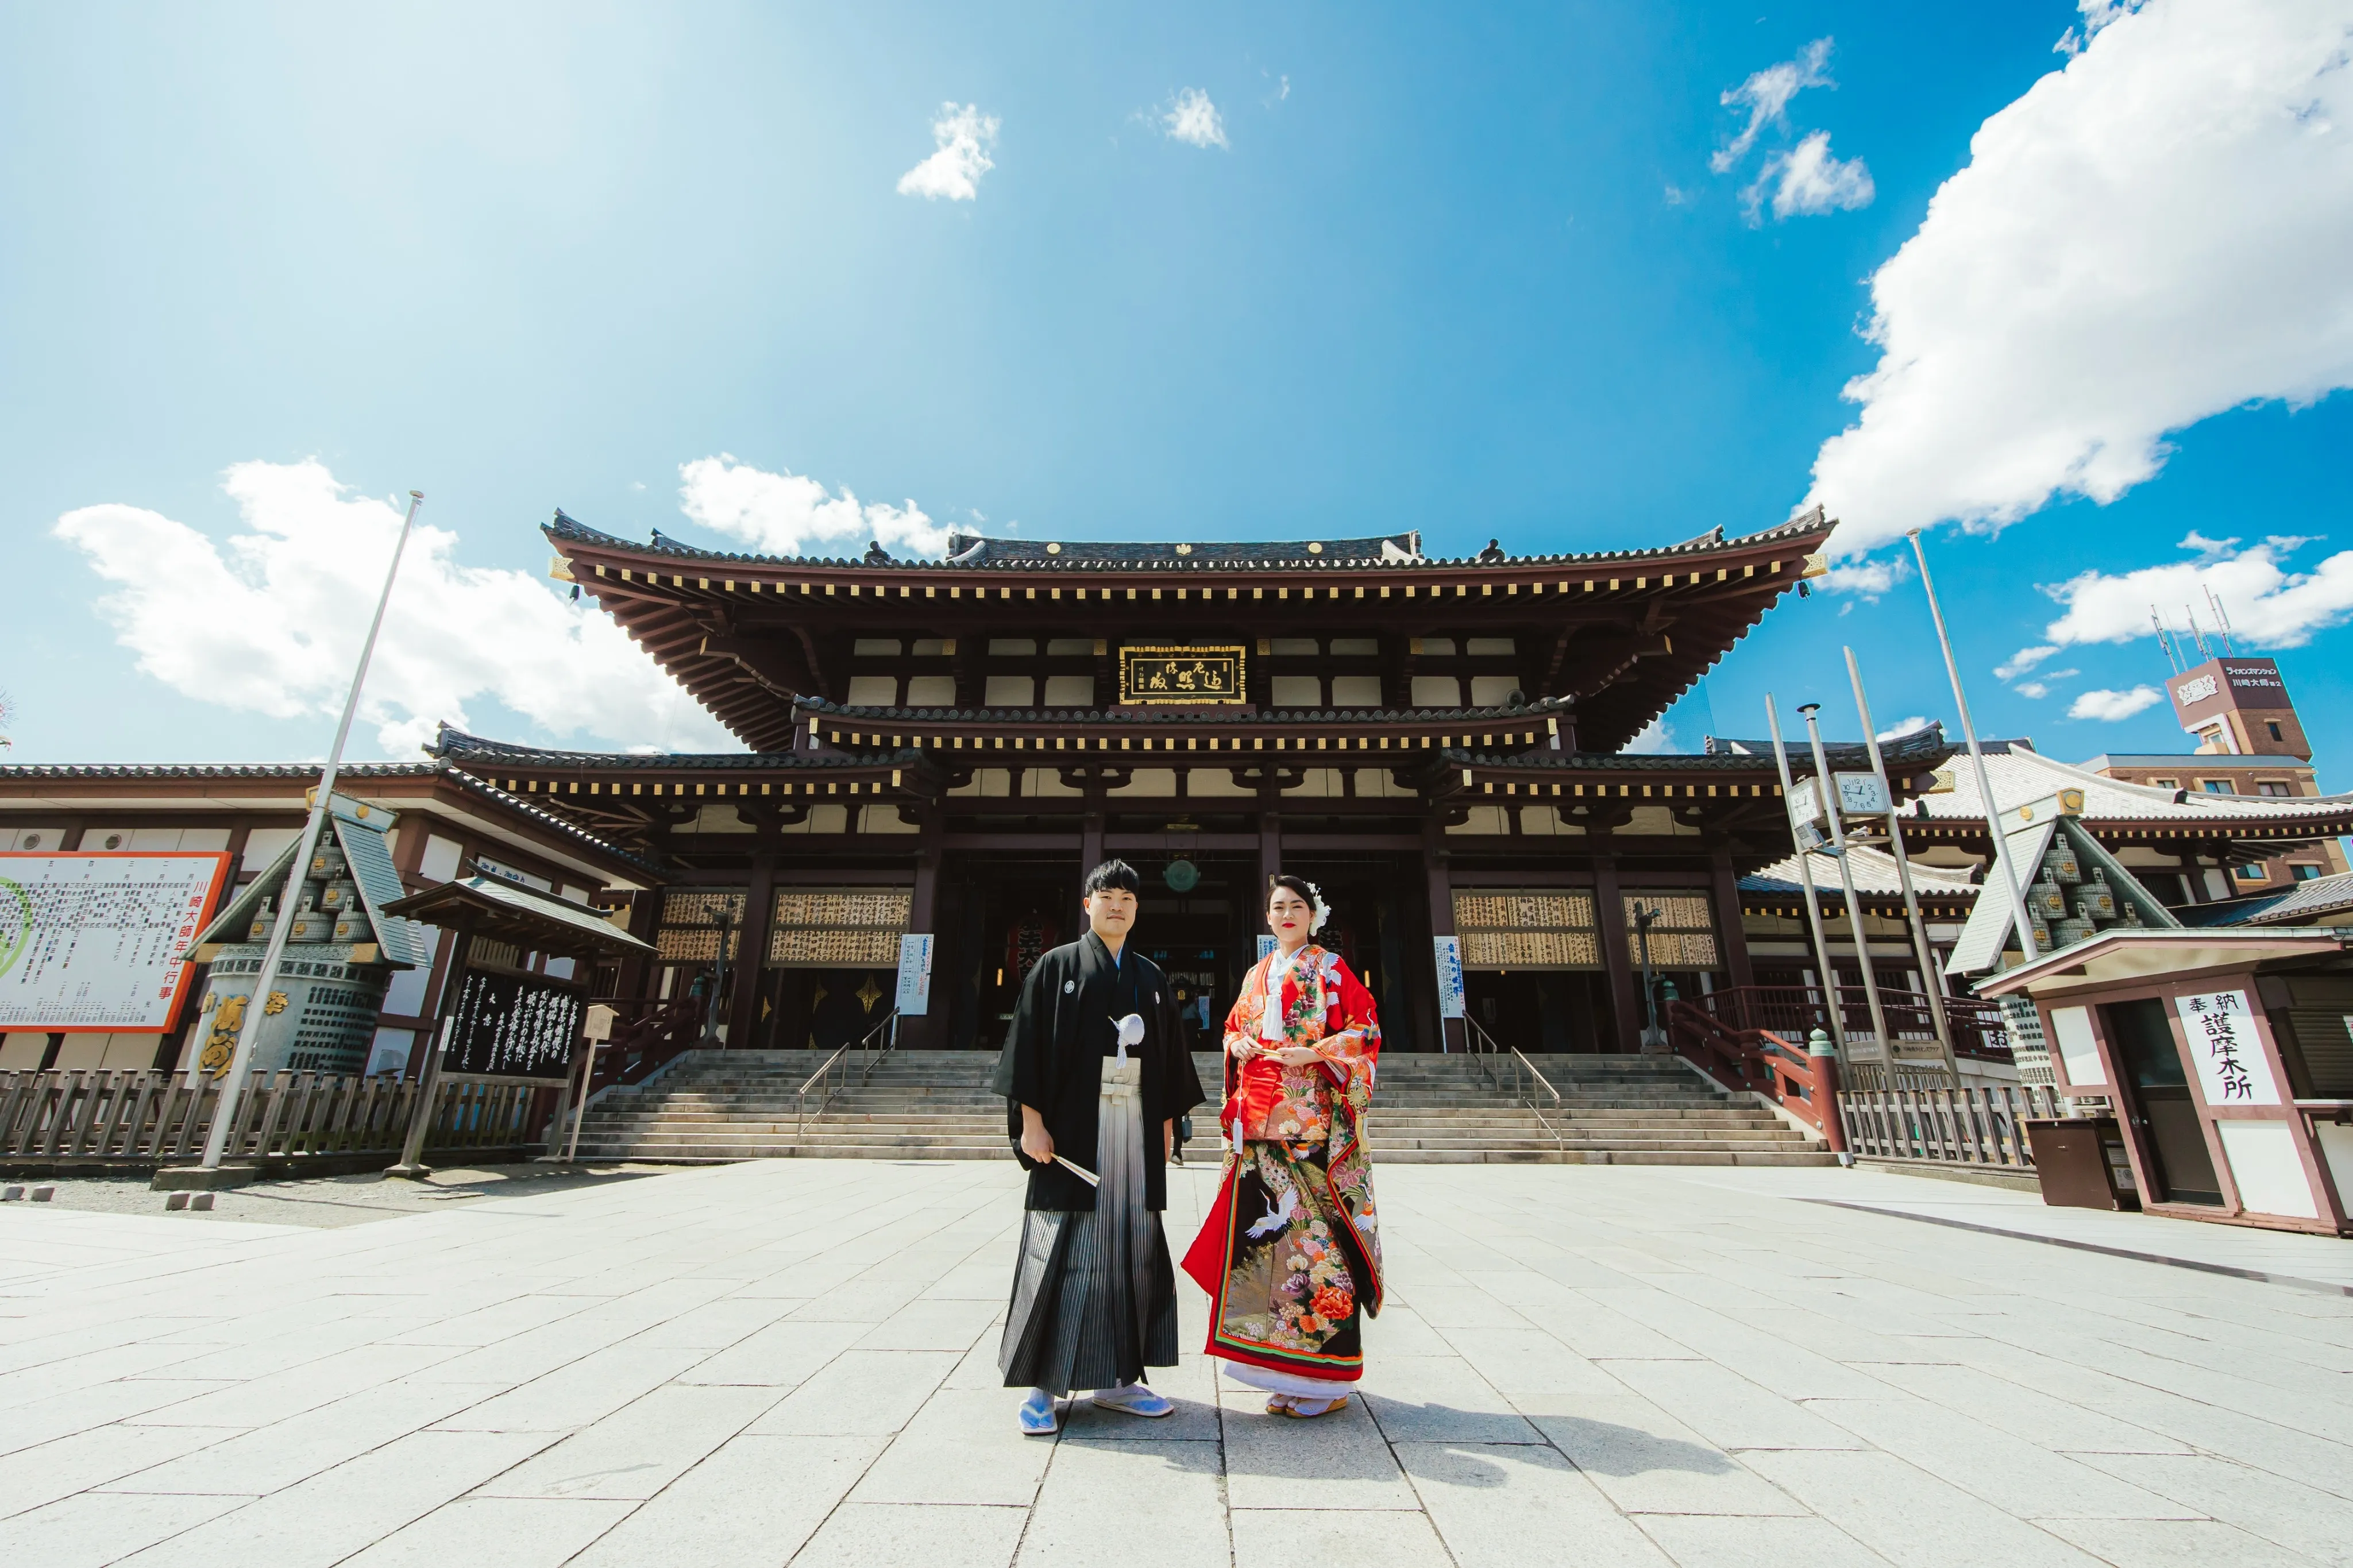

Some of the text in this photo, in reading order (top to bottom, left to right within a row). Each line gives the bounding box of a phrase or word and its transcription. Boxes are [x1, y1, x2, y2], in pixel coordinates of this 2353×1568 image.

[2225, 667, 2277, 675] ライオンズマンション
[158, 881, 208, 1000] 川崎大師年中行事
[2189, 994, 2239, 1013] 奉納
[2200, 1011, 2253, 1100] 護摩木所
